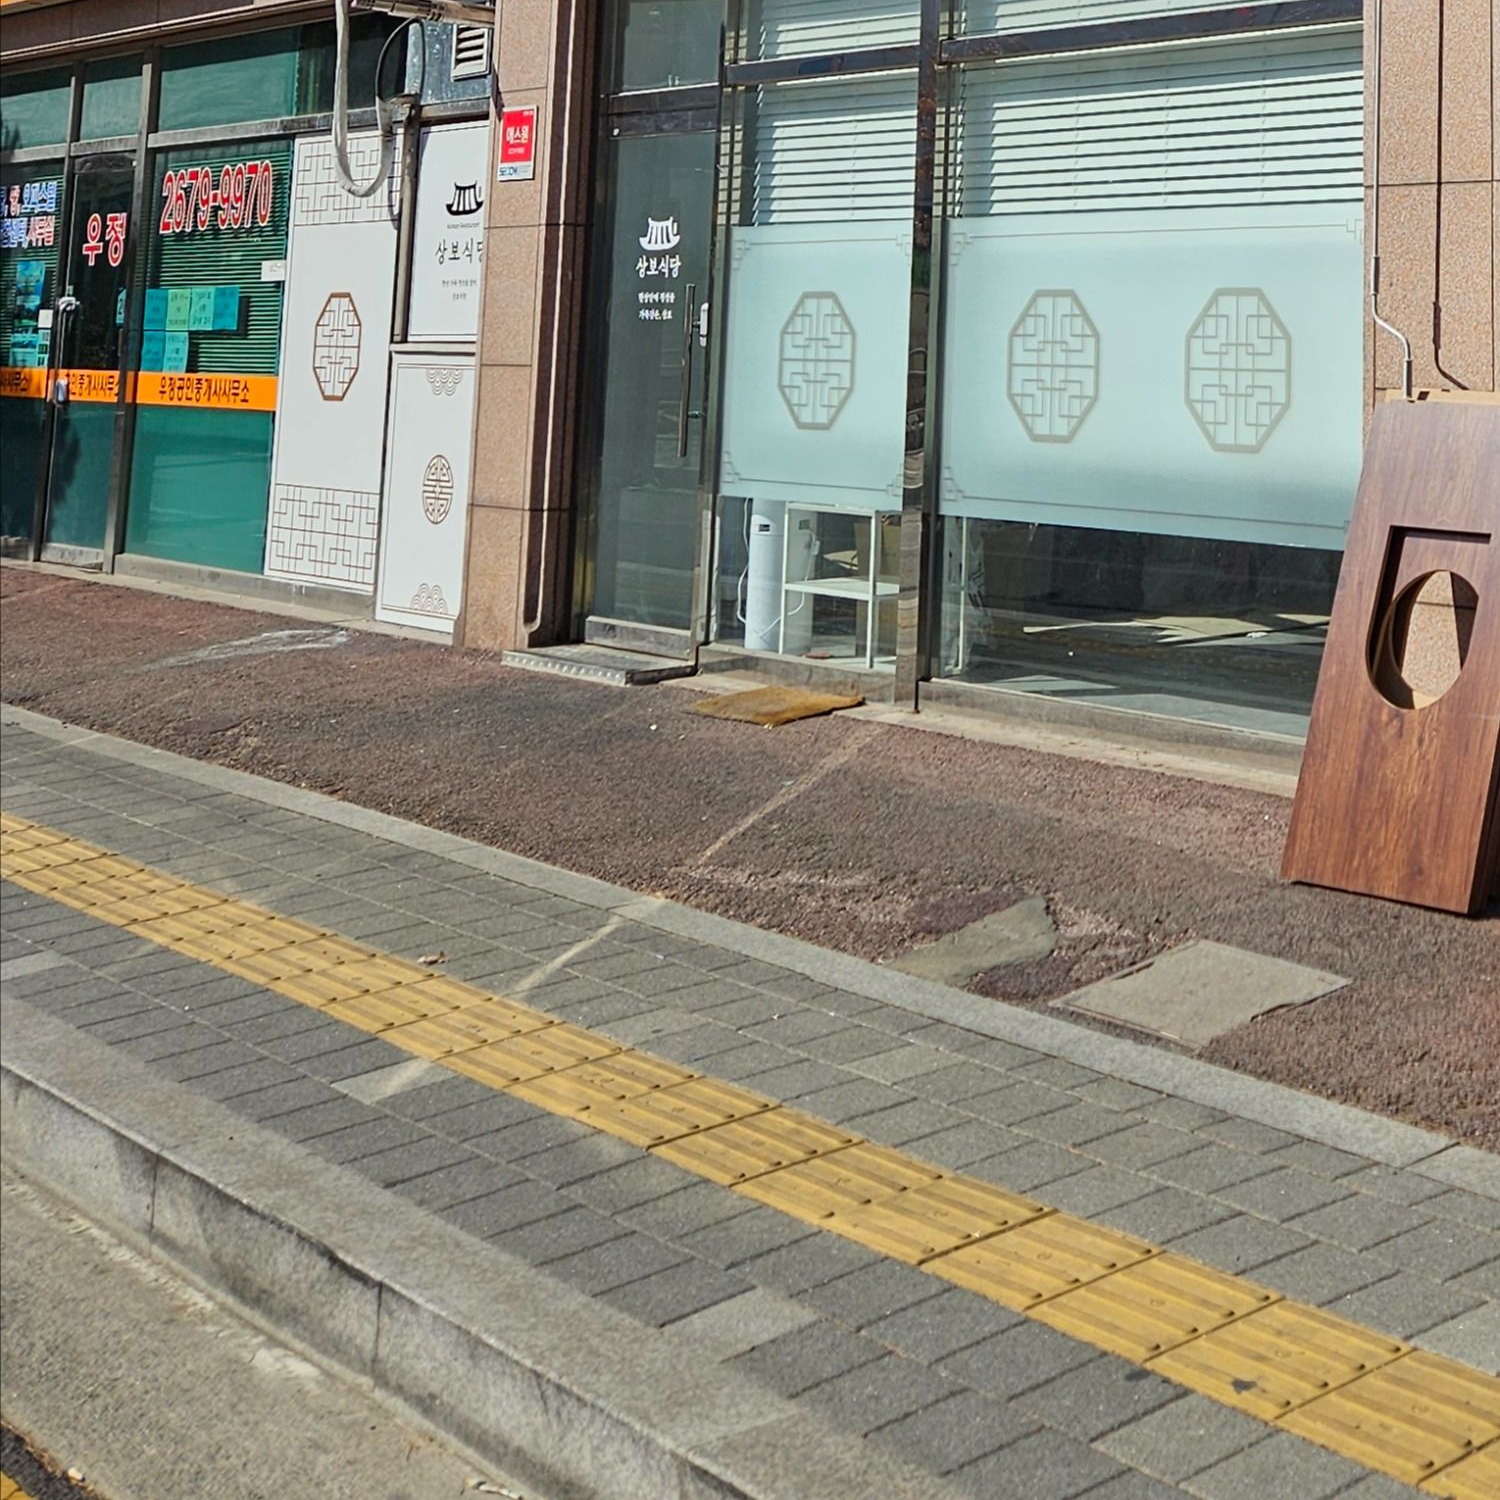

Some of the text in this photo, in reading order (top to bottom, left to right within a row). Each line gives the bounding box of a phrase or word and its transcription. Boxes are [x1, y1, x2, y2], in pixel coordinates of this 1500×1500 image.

[159, 160, 273, 234] 2679-9970
[82, 211, 127, 267] 우정
[635, 254, 682, 279] 상보식당
[158, 376, 250, 404] 우정공인중개사사무소
